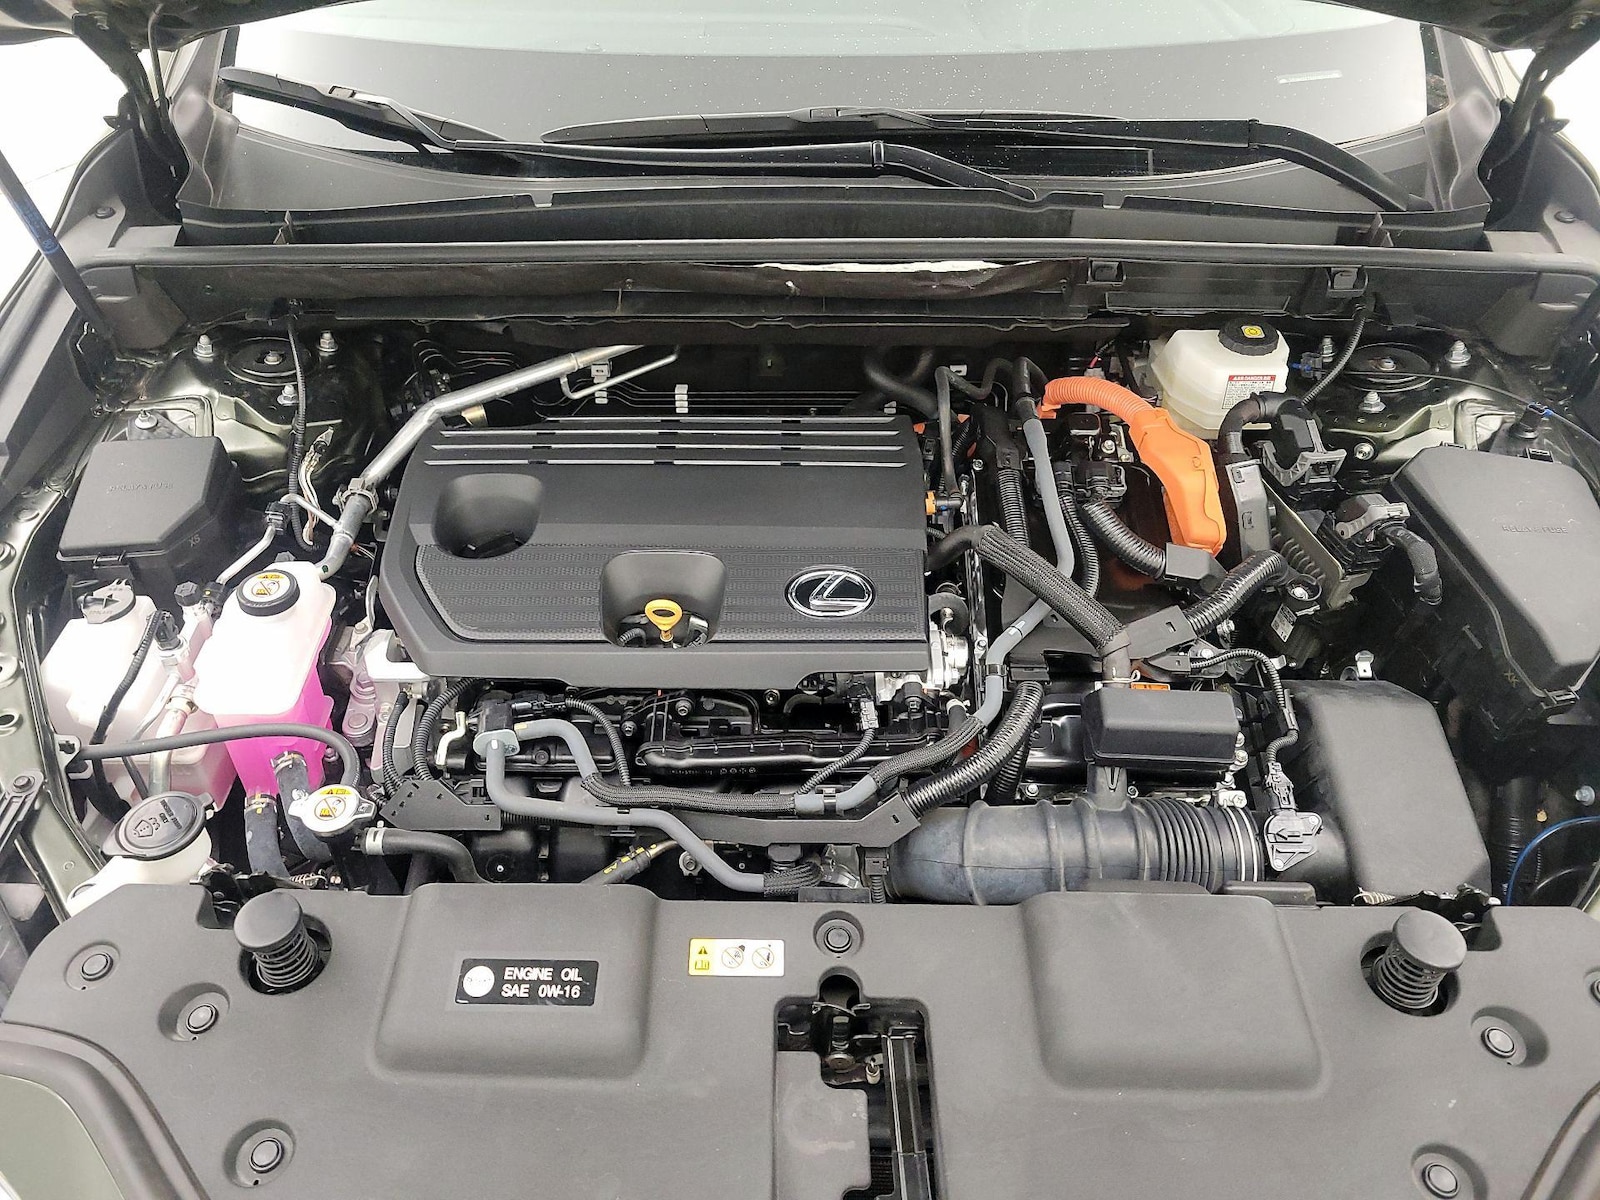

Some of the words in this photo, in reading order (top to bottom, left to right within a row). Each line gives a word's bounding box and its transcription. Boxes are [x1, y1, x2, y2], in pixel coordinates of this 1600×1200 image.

[503, 966, 554, 981] ENGINE
[560, 967, 583, 982] OIL
[501, 983, 530, 998] SAE
[538, 984, 581, 998] 0W-16
